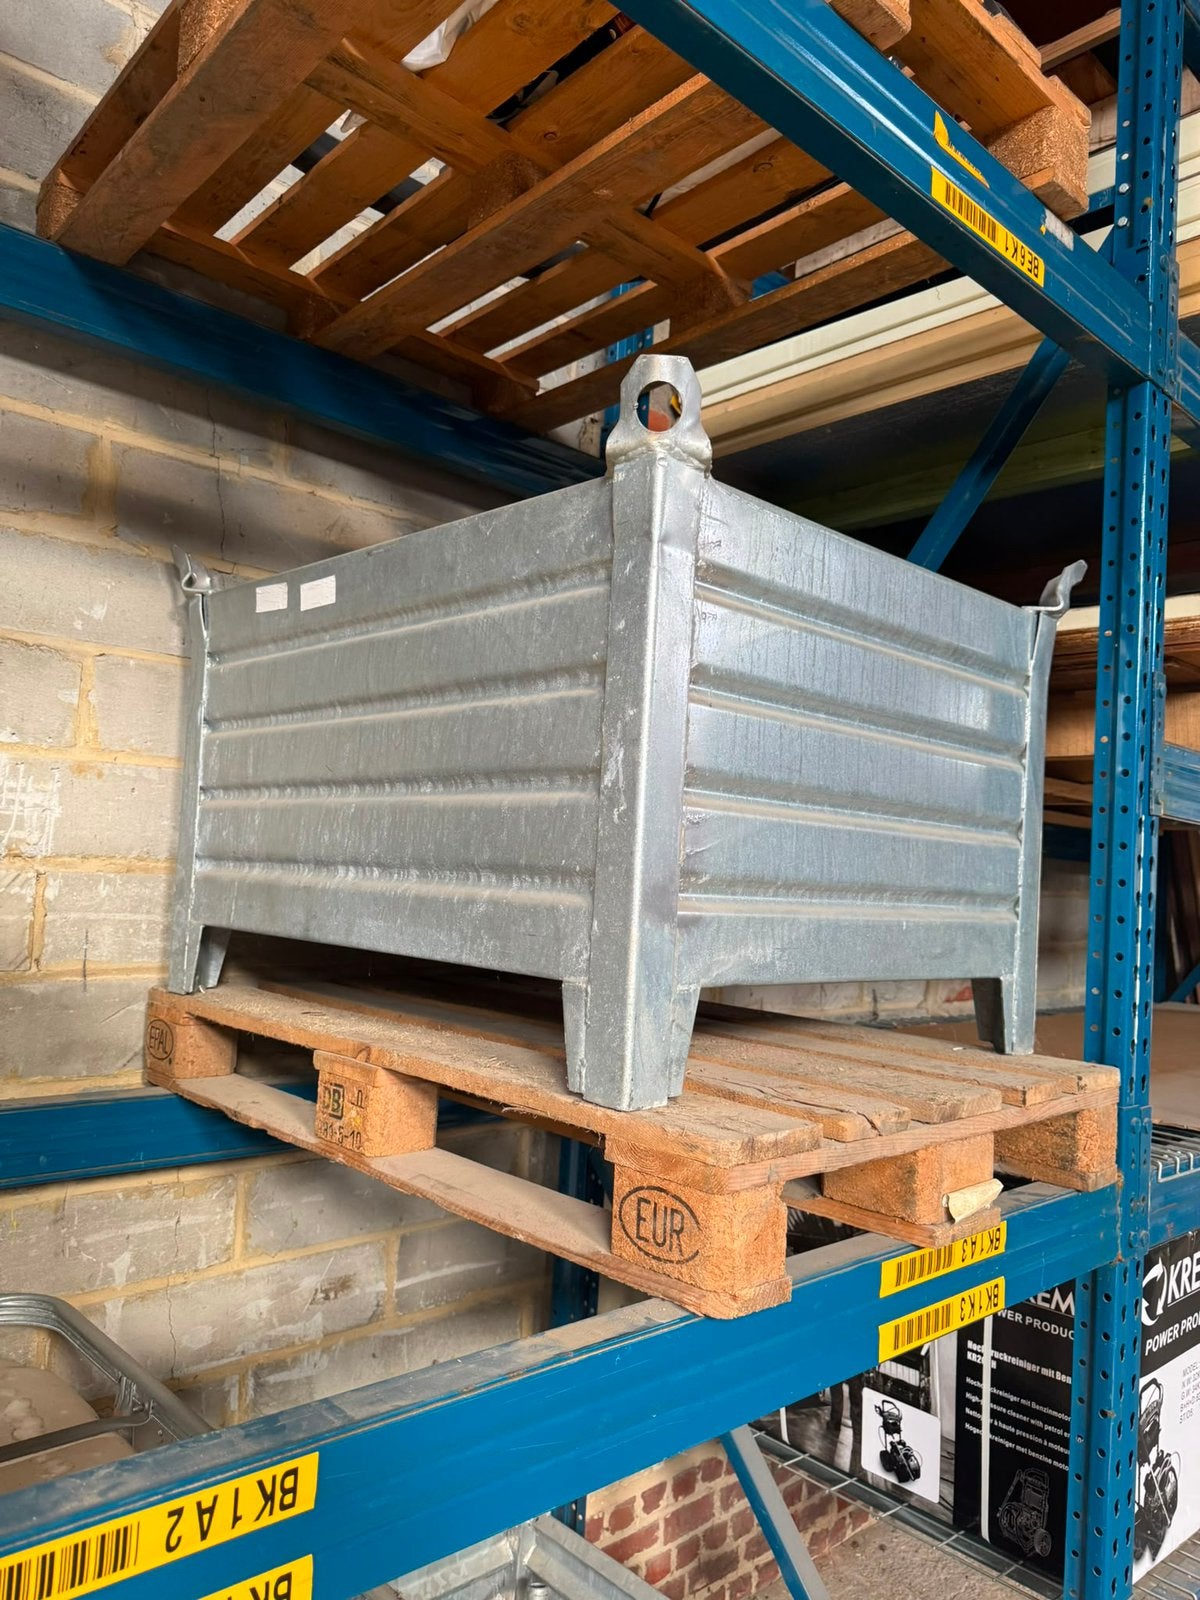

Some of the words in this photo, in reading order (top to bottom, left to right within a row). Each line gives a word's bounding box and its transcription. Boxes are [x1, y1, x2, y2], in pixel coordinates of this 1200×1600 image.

[1004, 231, 1040, 278] BE6K1
[149, 1025, 169, 1055] EPAL
[635, 1196, 685, 1257] EUR
[1145, 1323, 1180, 1356] POWER
[1180, 1311, 1200, 1336] PRO
[1041, 1365, 1055, 1379] mit
[1020, 1398, 1031, 1407] mit
[998, 1420, 1016, 1433] haute
[1016, 1429, 1042, 1445] pression
[1007, 1409, 1029, 1423] cleaner
[1030, 1419, 1044, 1429] with
[1044, 1424, 1063, 1435] petrol
[1015, 1445, 1028, 1455] met
[1028, 1448, 1052, 1465] benzine
